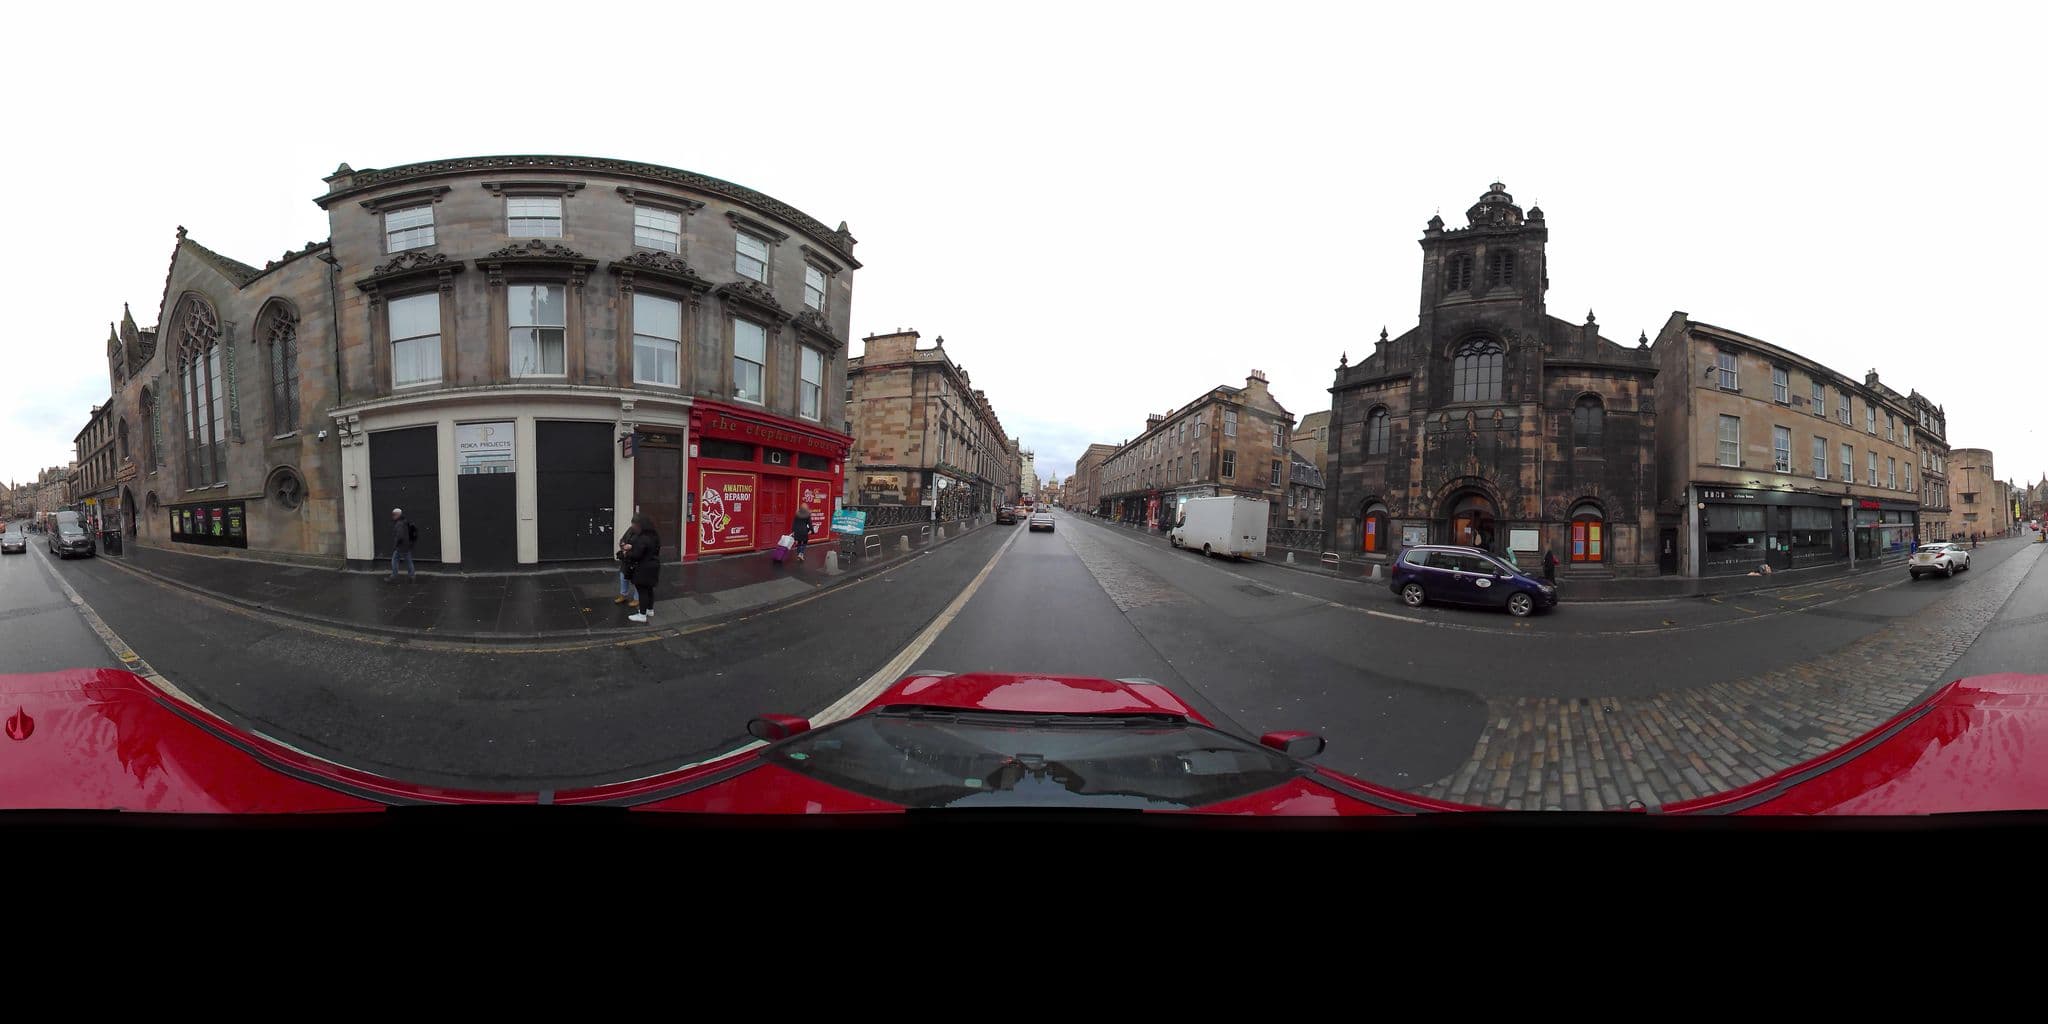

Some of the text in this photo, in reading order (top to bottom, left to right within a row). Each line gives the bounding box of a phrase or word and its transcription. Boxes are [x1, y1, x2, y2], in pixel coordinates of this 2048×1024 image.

[712, 417, 737, 431] the
[746, 425, 801, 443] elephant
[723, 484, 753, 493] AWAITING
[724, 493, 751, 501] REPARO!
